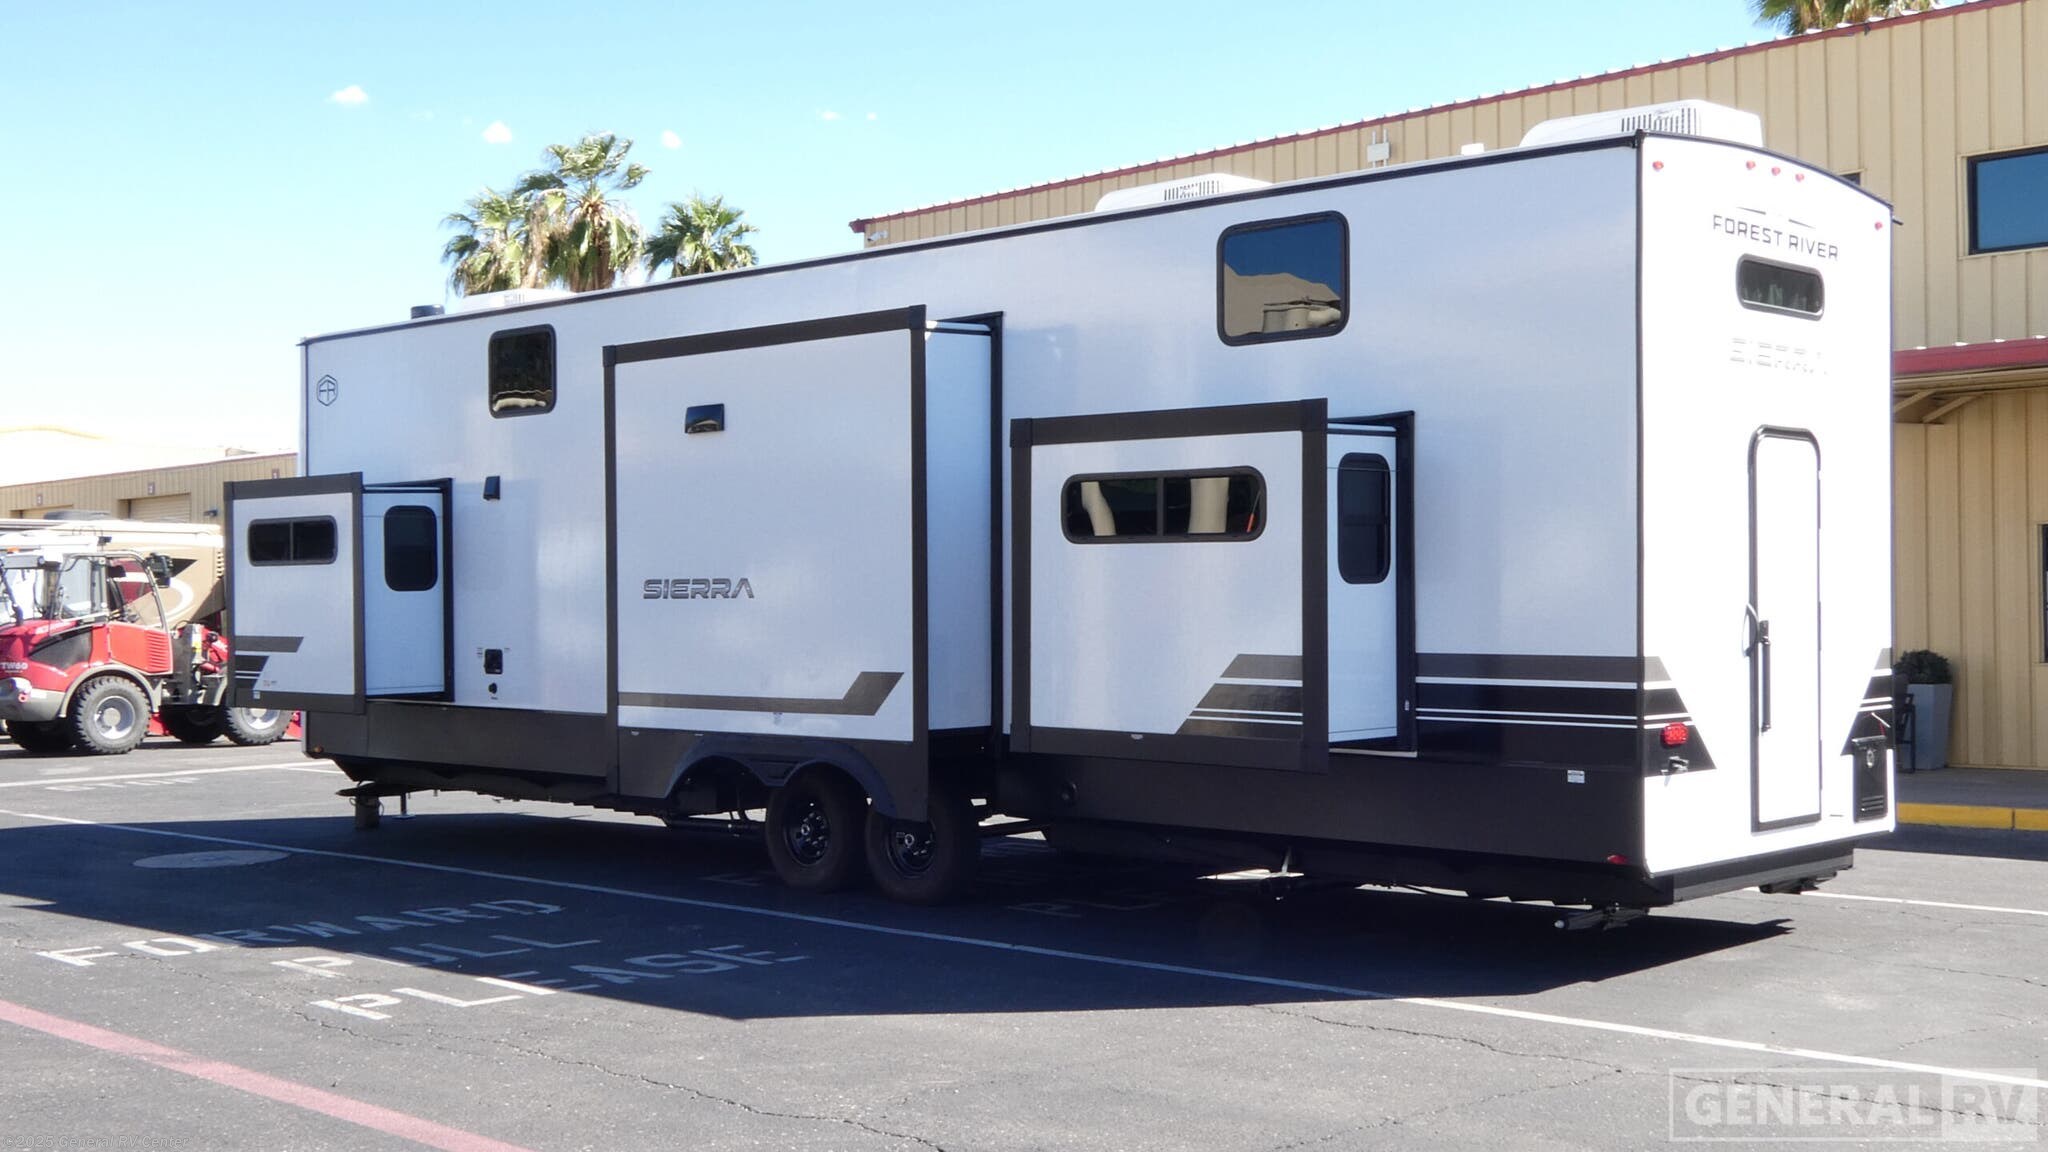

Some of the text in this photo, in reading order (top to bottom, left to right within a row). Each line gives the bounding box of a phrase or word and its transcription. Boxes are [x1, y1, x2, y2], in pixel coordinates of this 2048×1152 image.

[1713, 213, 1838, 261] FOREST RIVER
[1728, 336, 1829, 376] SERR
[643, 577, 755, 600] SIERRA
[34, 899, 565, 967] FORWARD
[271, 934, 600, 977] PULL
[311, 944, 810, 1020] PLEASE
